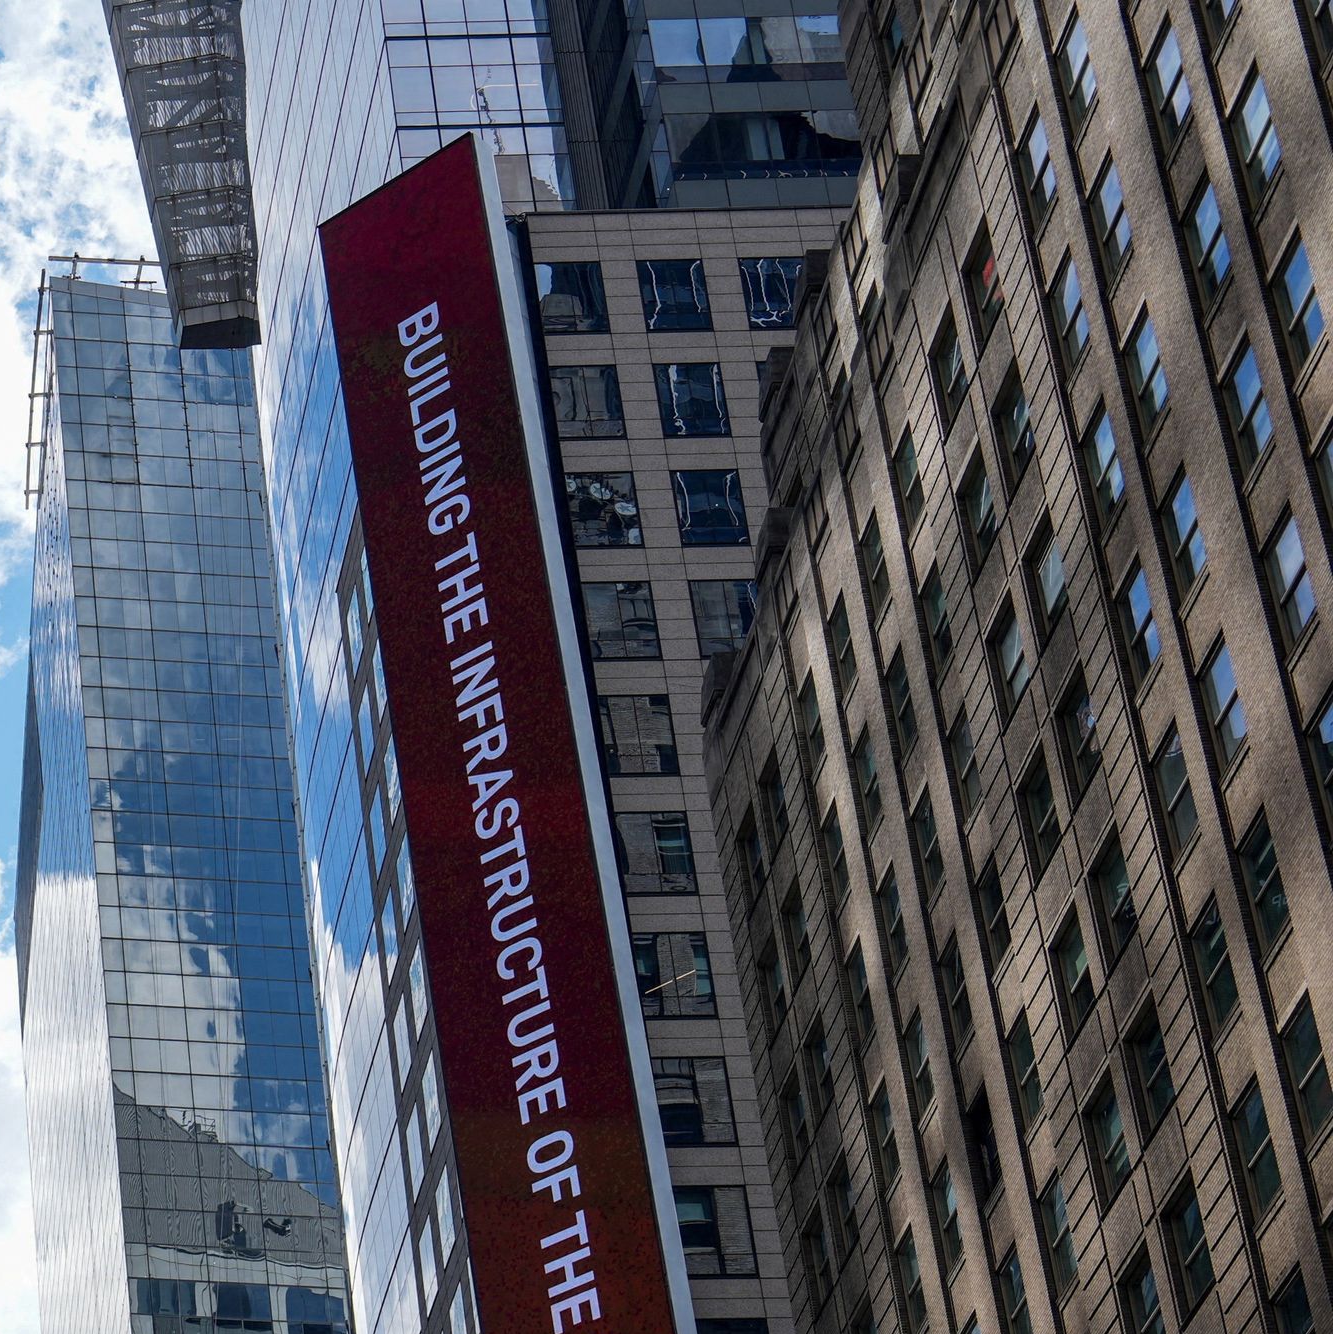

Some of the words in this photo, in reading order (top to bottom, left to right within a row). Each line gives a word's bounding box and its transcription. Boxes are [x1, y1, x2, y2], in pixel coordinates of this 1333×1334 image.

[397, 301, 471, 536] BUILDING
[434, 531, 489, 645] THE
[449, 640, 567, 1125] INFRASTRUCTURE
[526, 1130, 581, 1203] OF
